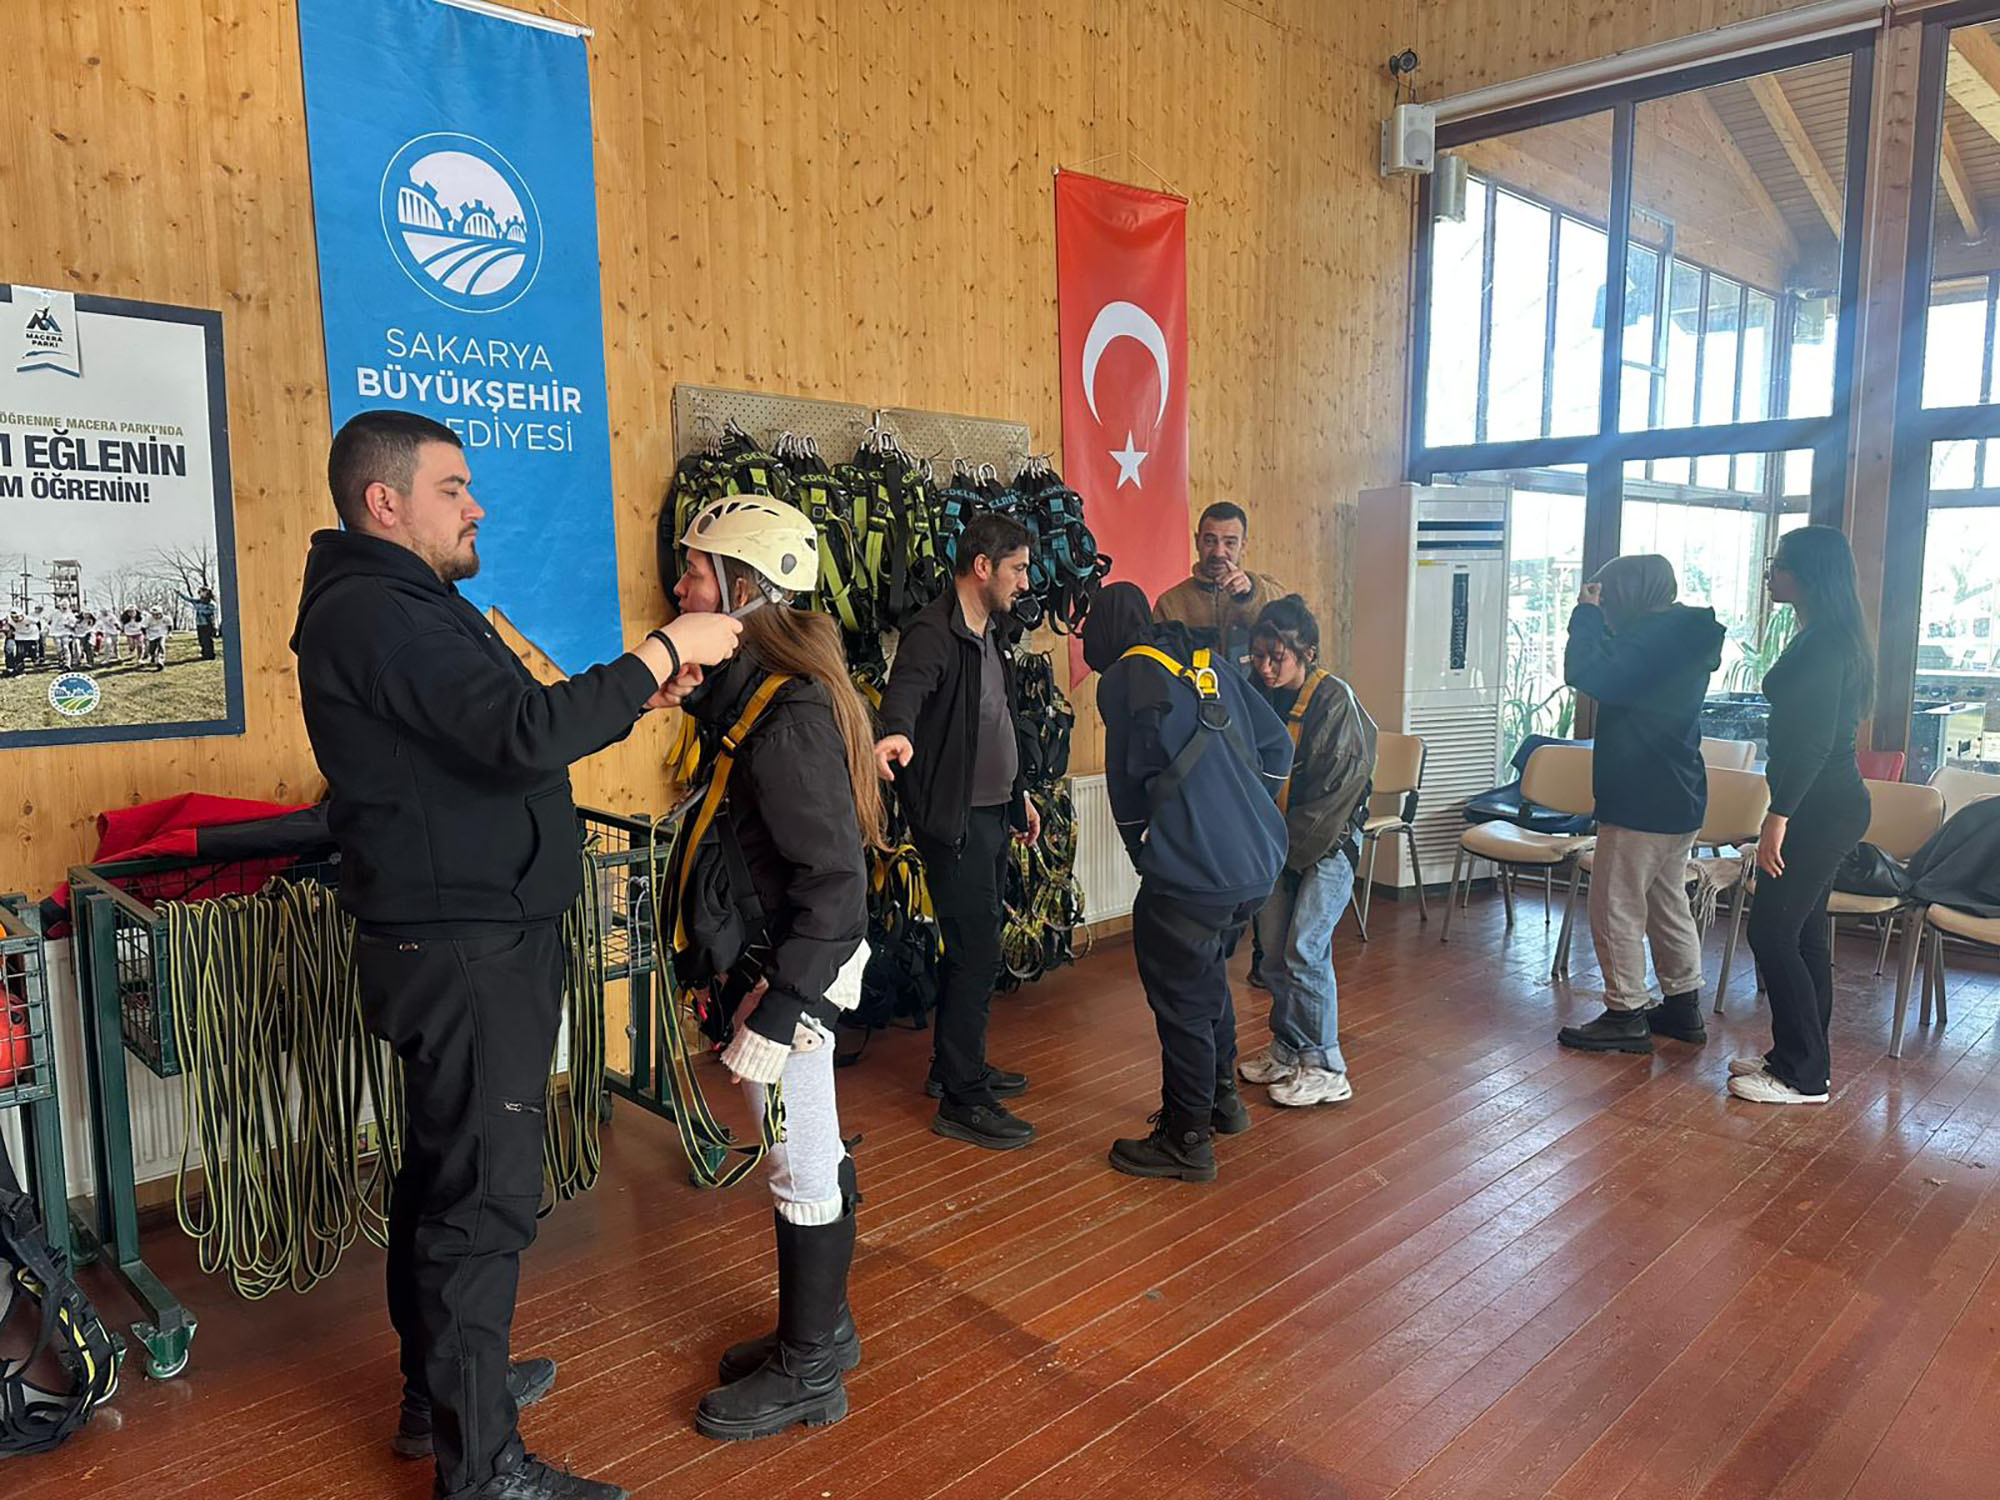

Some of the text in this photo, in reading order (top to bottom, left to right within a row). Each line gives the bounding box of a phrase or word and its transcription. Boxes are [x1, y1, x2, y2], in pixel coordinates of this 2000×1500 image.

[26, 333, 63, 342] MACERA
[386, 328, 553, 372] SAKARYA
[357, 364, 581, 414] BÜYÜKŞEHİR
[66, 418, 118, 433] MACERA
[120, 423, 184, 437] PARKI'NDA
[445, 415, 573, 452] EDİYESİ
[24, 428, 187, 477] EĞLENİN
[31, 472, 150, 503] ÖĞRENİN!
